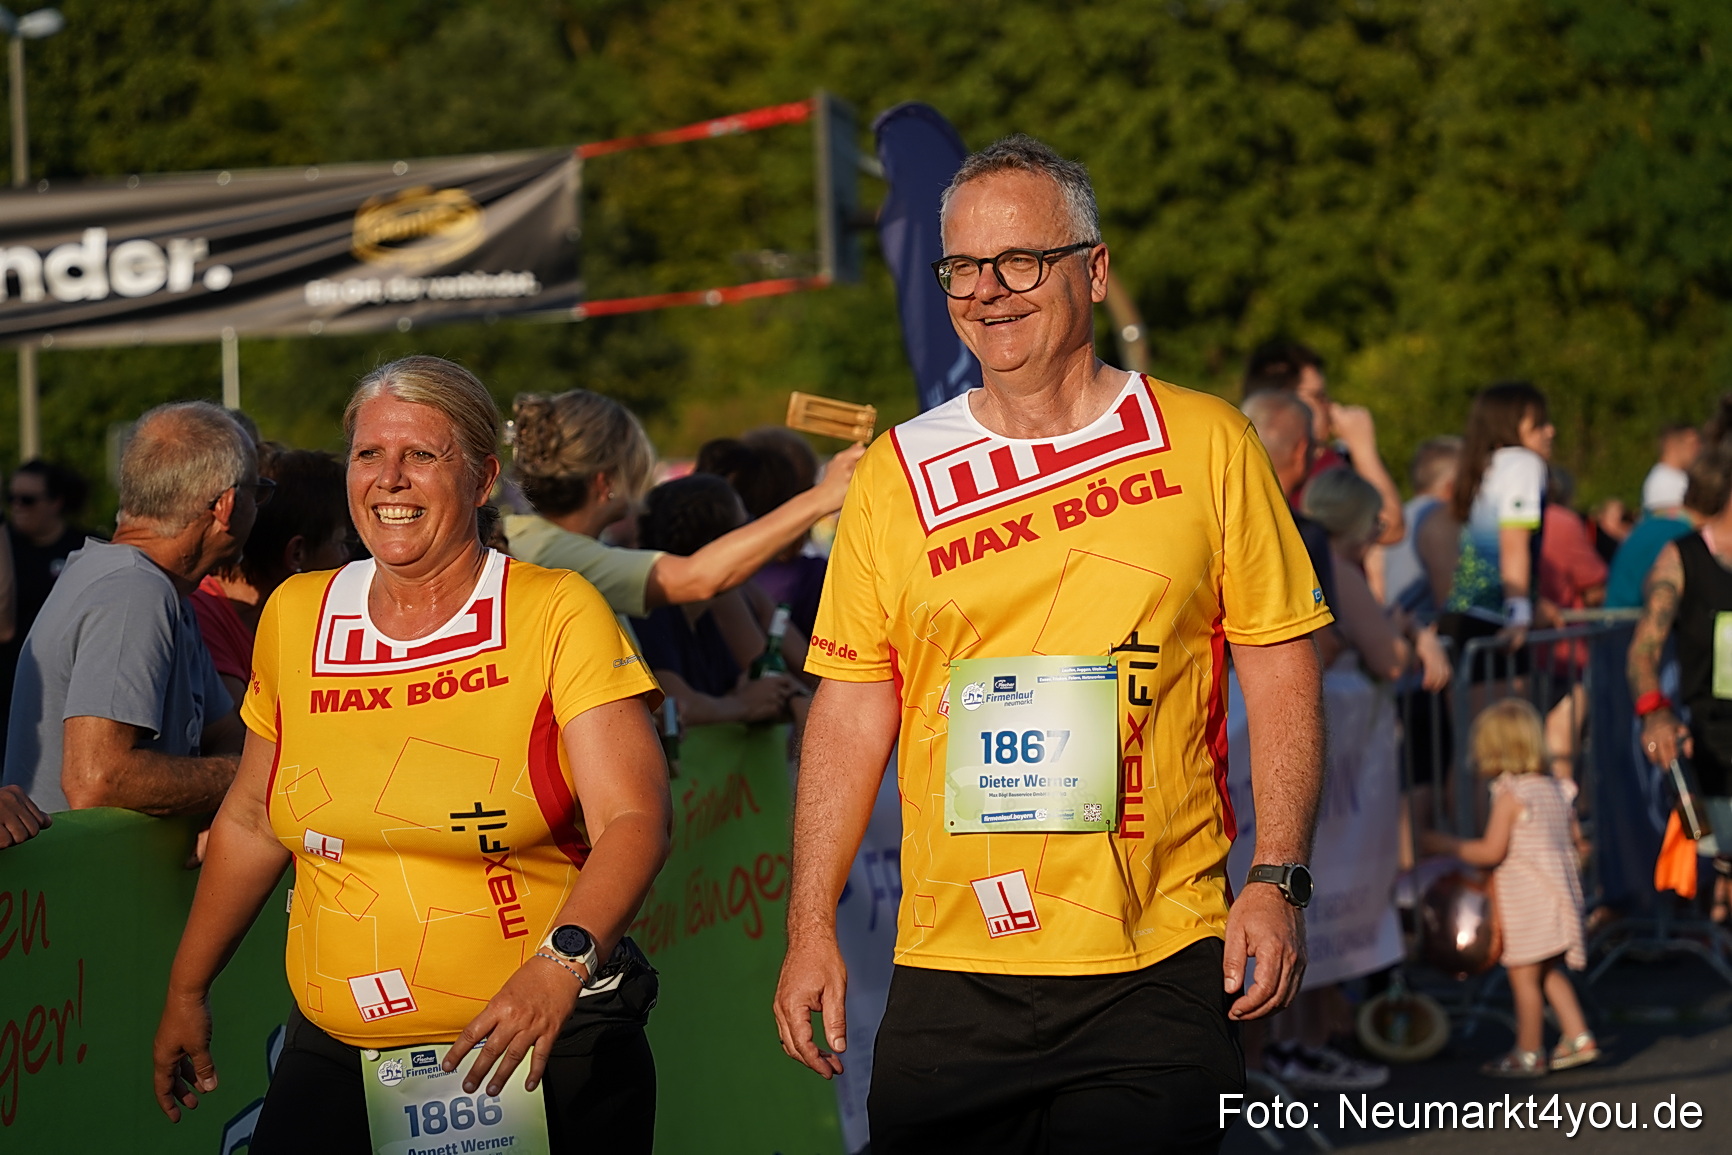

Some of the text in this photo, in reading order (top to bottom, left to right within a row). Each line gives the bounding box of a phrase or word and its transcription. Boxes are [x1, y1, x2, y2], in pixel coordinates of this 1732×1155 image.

[927, 468, 1183, 577] MAX BÖGL
[309, 664, 509, 714] MAX BÖGL
[986, 690, 1034, 703] Firmenlauf
[1004, 699, 1033, 707] neumarkt
[980, 729, 1071, 765] 1867
[979, 775, 1020, 788] Dieter
[404, 1093, 503, 1138] 1866
[461, 1135, 515, 1154] Werner
